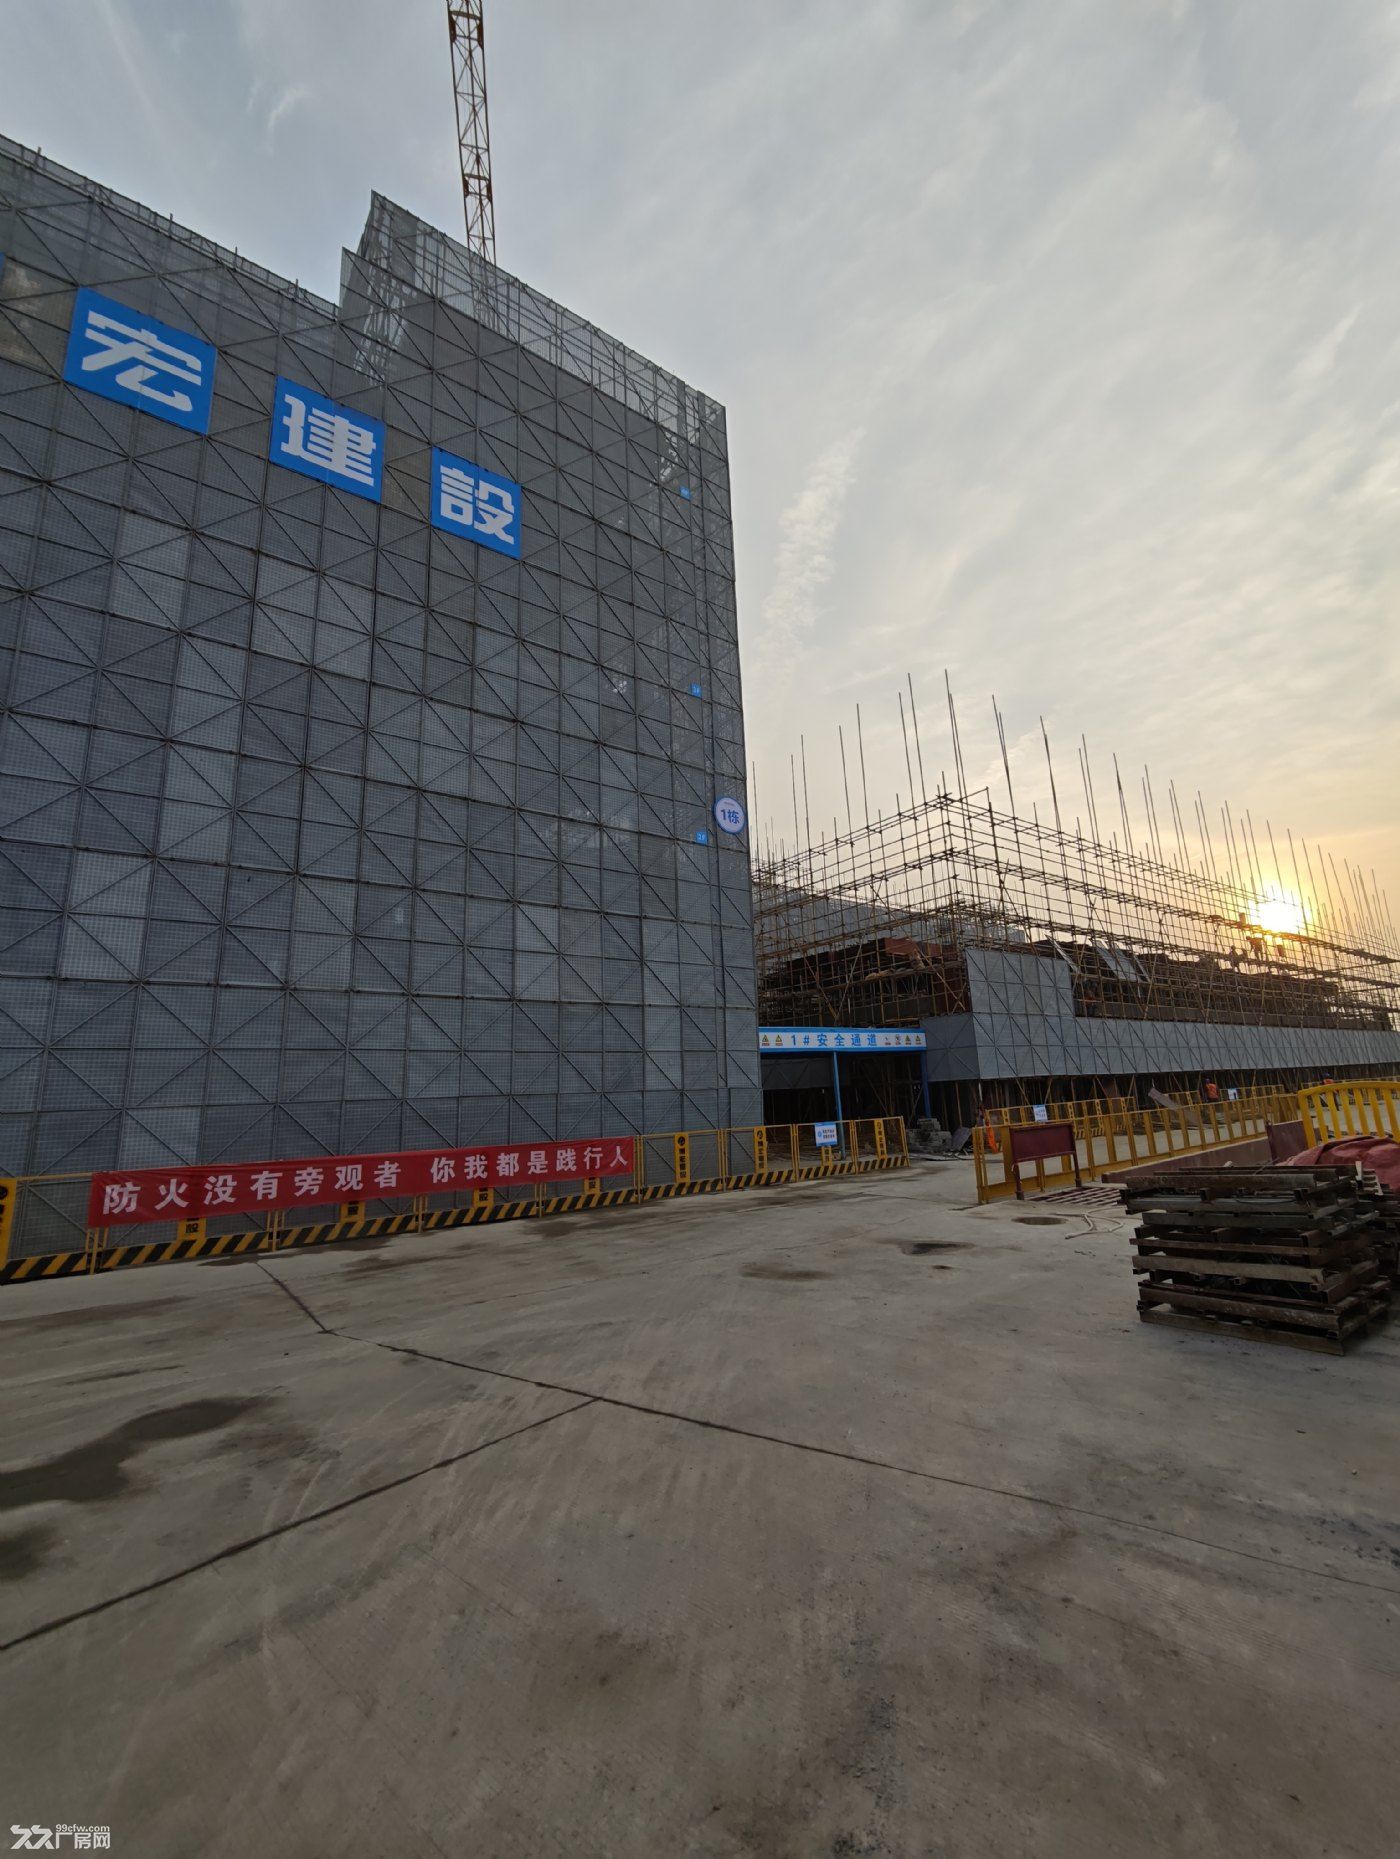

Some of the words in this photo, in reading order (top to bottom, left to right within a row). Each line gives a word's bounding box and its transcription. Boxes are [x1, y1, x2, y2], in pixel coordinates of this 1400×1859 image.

[720, 808, 740, 824] 1栋
[790, 1033, 878, 1047] 1#安全通道
[102, 1160, 402, 1216] 防火没有旁观者
[430, 1145, 628, 1184] 你我都是践行人
